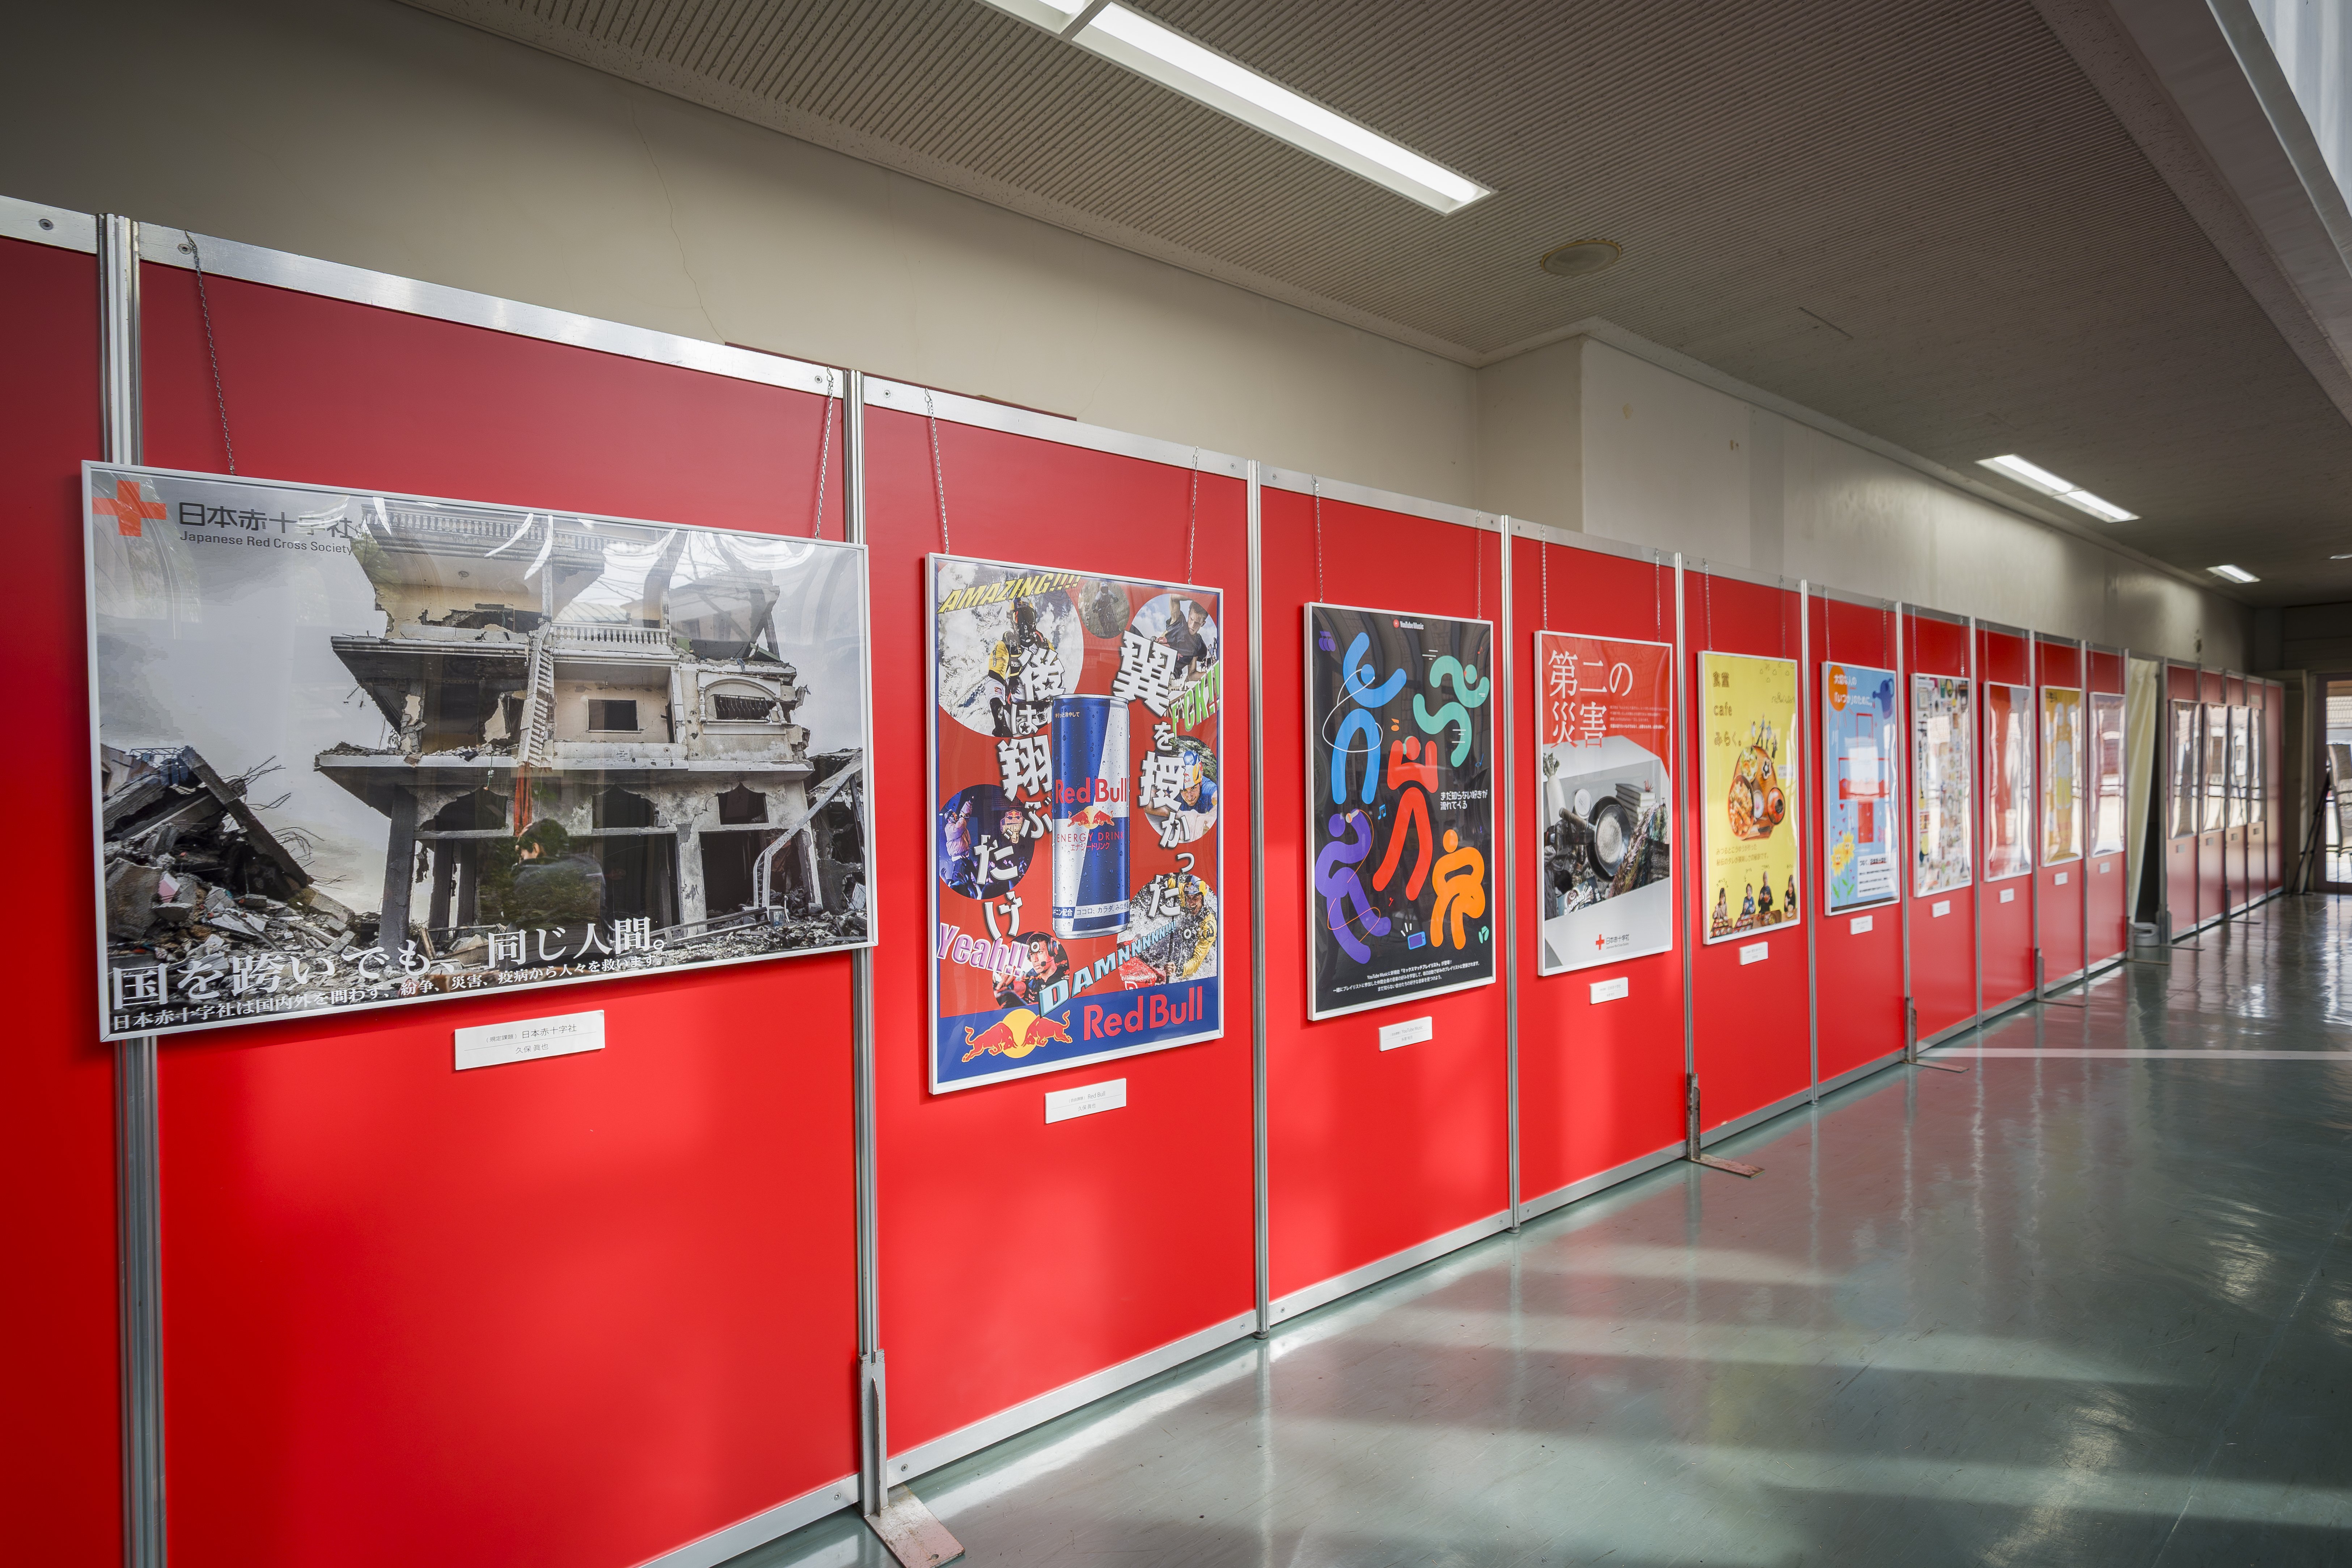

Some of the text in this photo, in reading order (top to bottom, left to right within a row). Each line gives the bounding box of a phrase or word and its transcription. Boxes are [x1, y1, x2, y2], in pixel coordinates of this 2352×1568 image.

[180, 531, 352, 555] Japanese Red Cross Society
[937, 572, 1081, 614] AMAZING!!!!
[1548, 650, 1633, 699] 第二の
[1713, 671, 1730, 688] 食堂
[1713, 702, 1733, 717] cafe
[1550, 701, 1607, 749] 災害
[1056, 777, 1127, 804] Red Bull
[1440, 789, 1488, 801] まだ知らない好きが
[1440, 800, 1467, 811] 流れてくる
[1057, 831, 1124, 842] ENERGY DRINK
[1071, 842, 1110, 851] エナジードリンク
[937, 922, 1030, 977] Yeah!!
[1084, 986, 1203, 1041] Red Bull
[522, 1024, 577, 1039] 日本赤十字社
